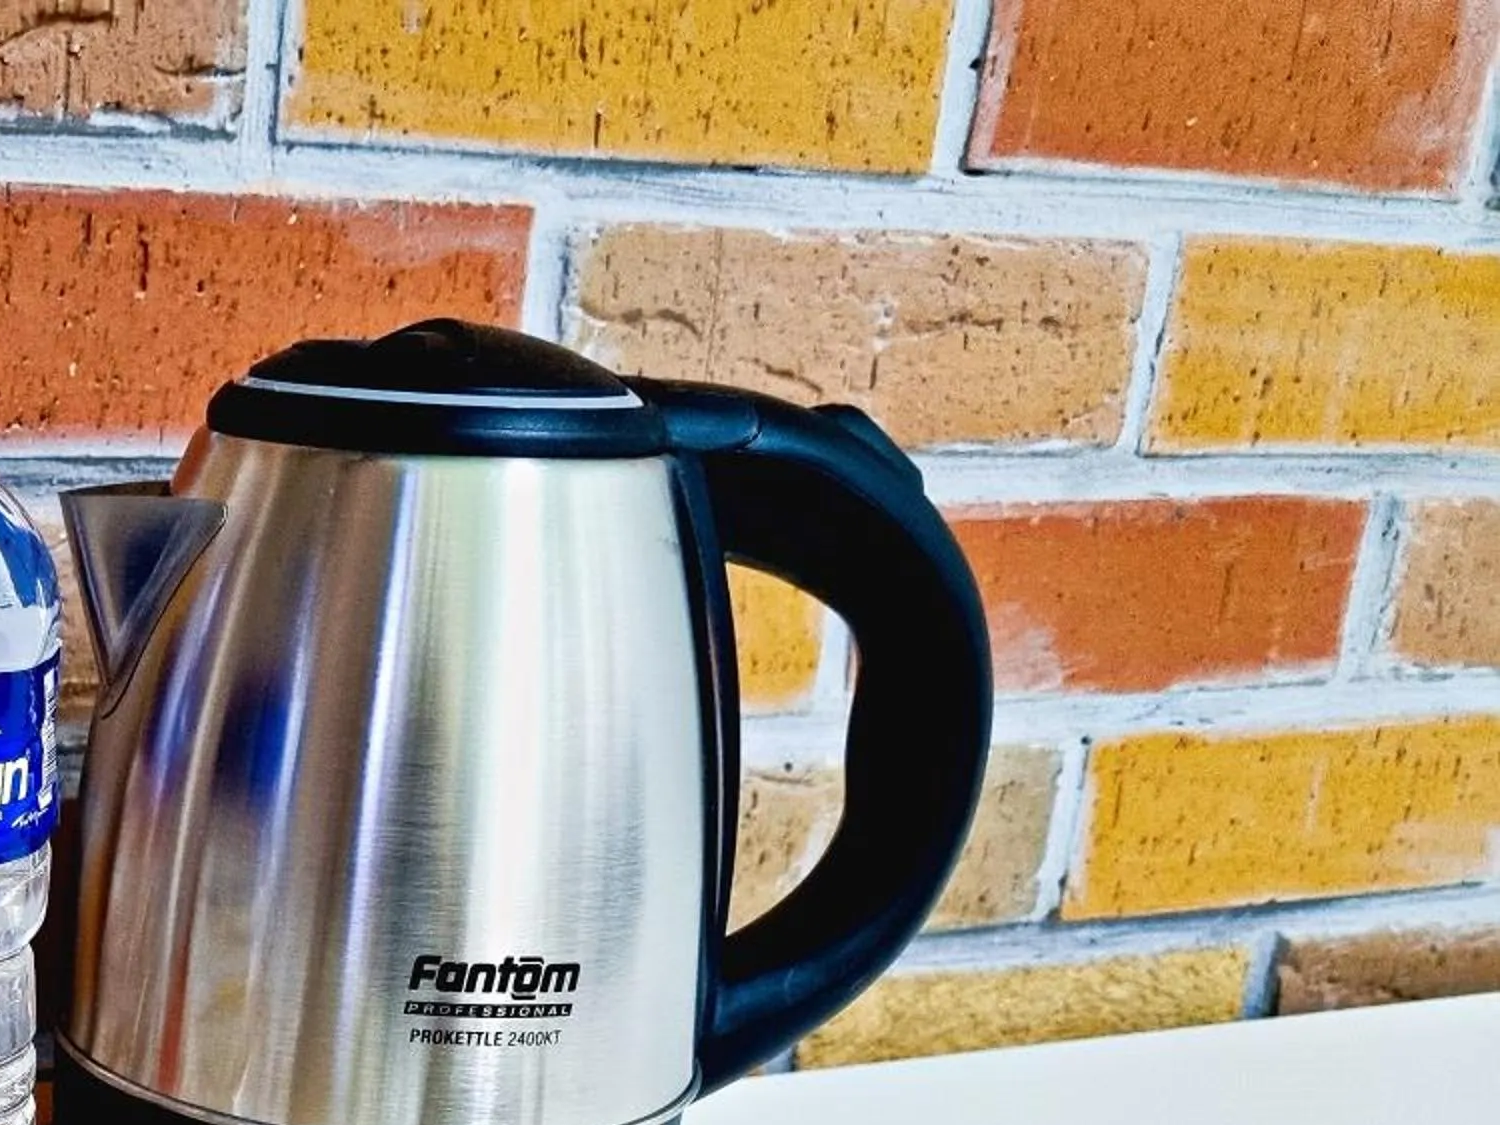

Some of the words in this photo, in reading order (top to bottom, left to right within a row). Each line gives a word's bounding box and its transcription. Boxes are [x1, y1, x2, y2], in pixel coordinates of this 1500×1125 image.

[408, 955, 581, 1000] Fantom
[407, 1002, 570, 1018] PROFESSIONAL
[410, 1028, 503, 1047] PROKETTLE
[507, 1030, 563, 1047] 2400KT
